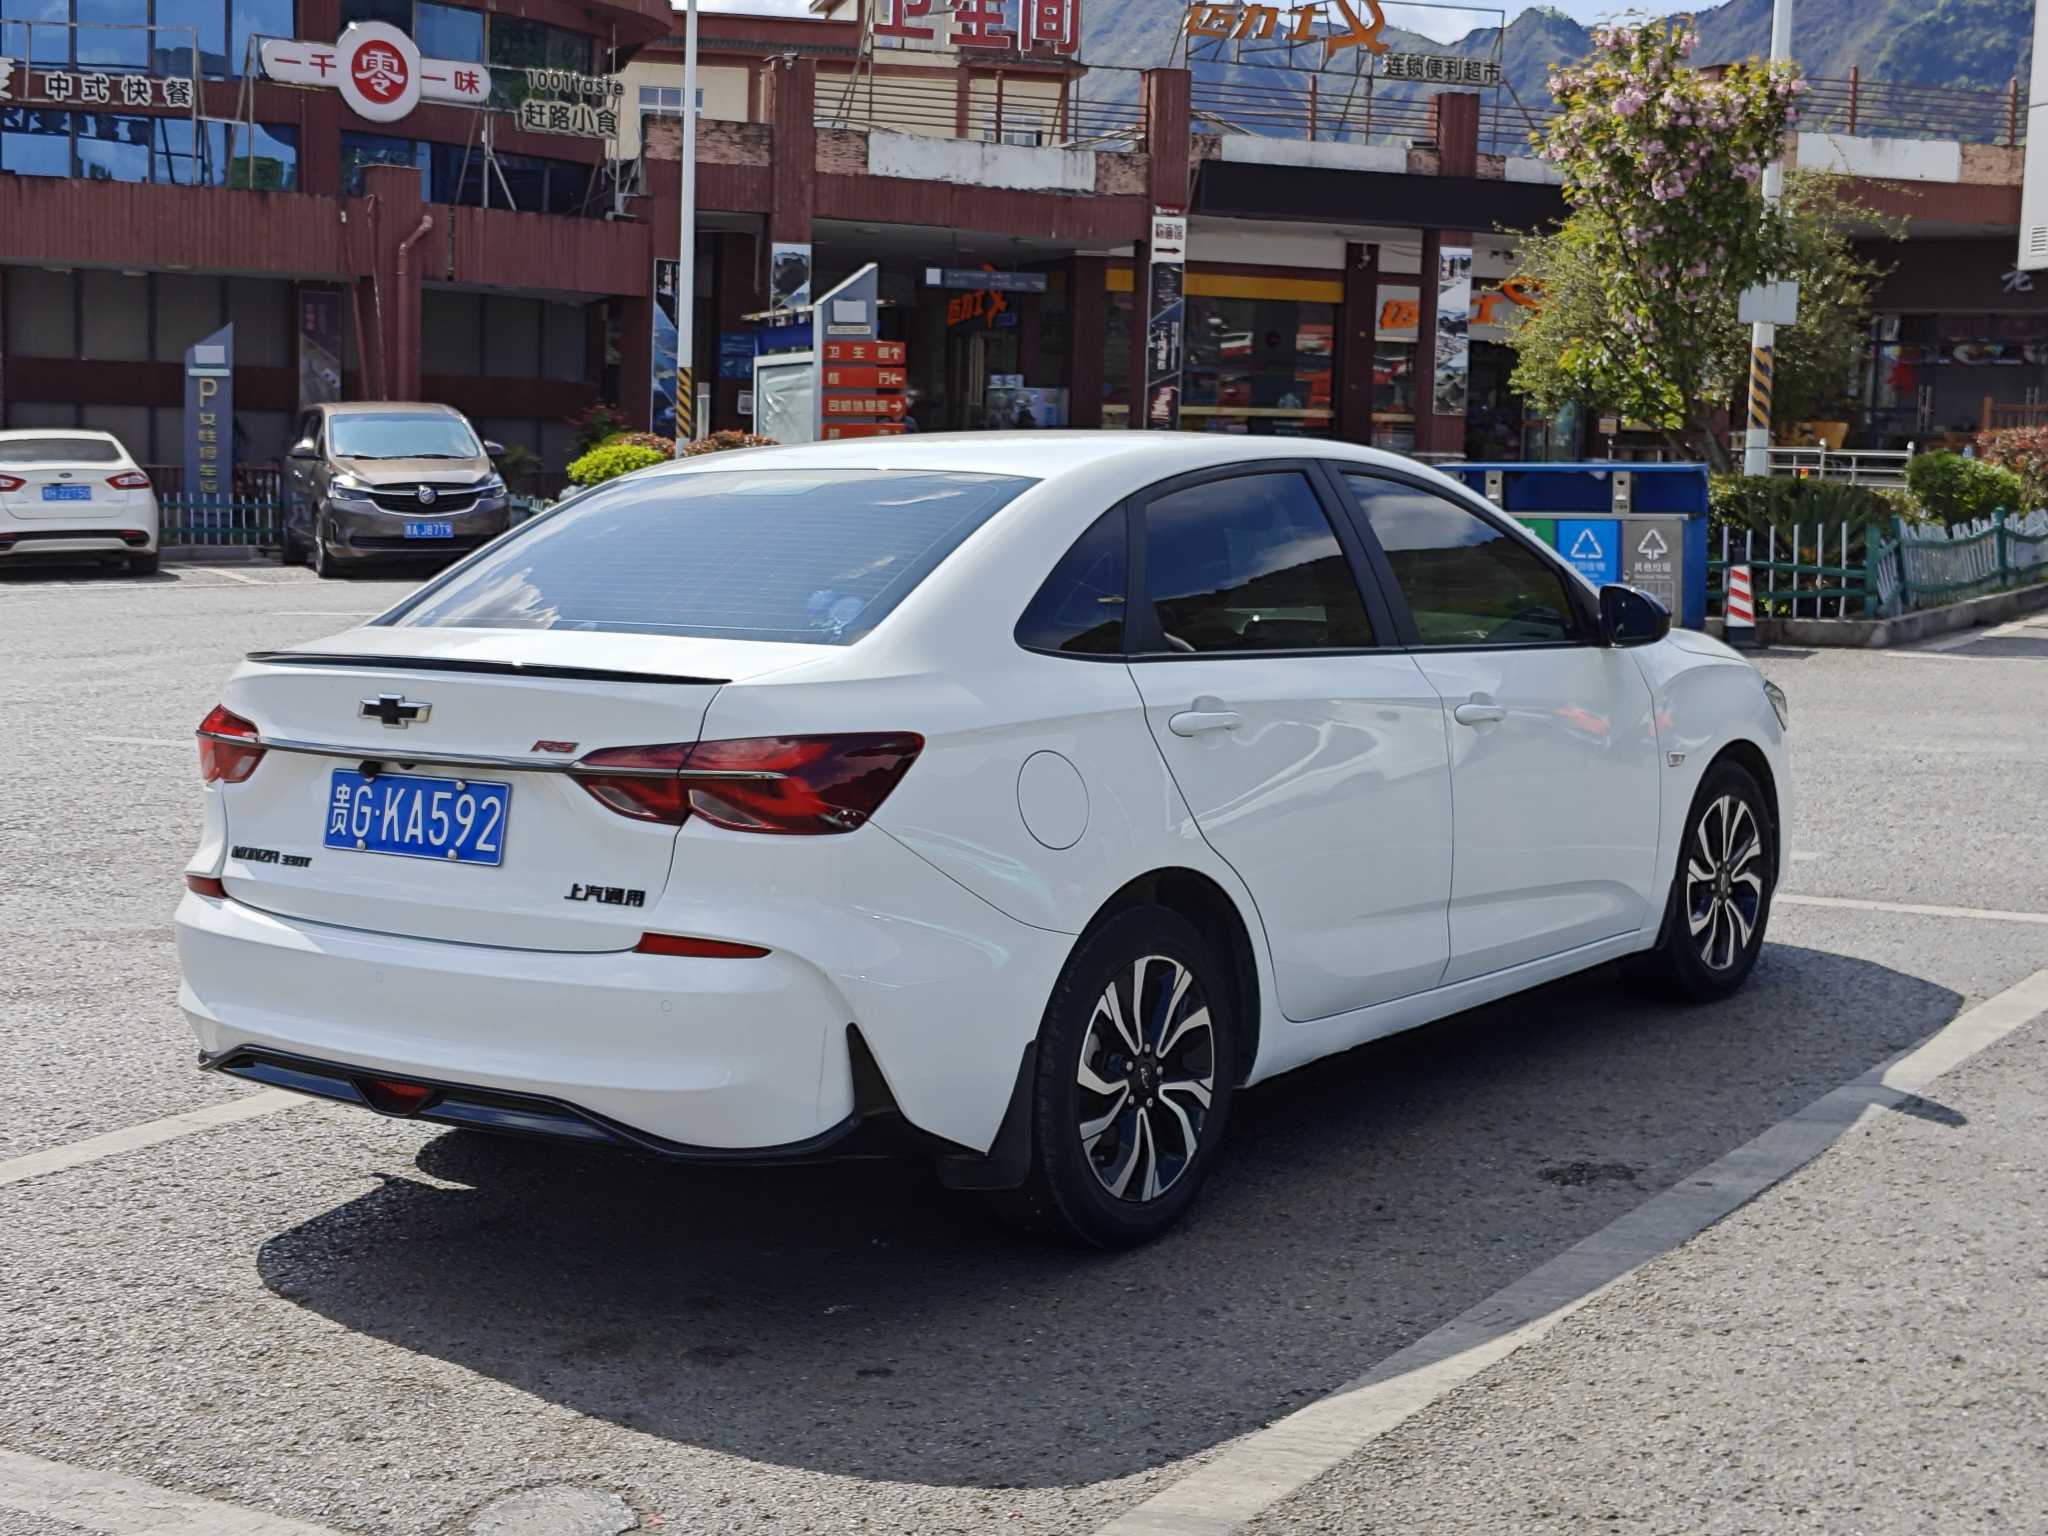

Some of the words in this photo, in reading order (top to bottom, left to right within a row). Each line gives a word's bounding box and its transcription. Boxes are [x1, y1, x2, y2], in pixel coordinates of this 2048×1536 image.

[526, 67, 625, 97] 1001taste
[1382, 54, 1501, 84] 连锁便利超市
[46, 71, 193, 107] 中式快餐
[522, 102, 619, 138] 赶路小食
[199, 378, 218, 408] P
[563, 882, 646, 908] 上汽通用
